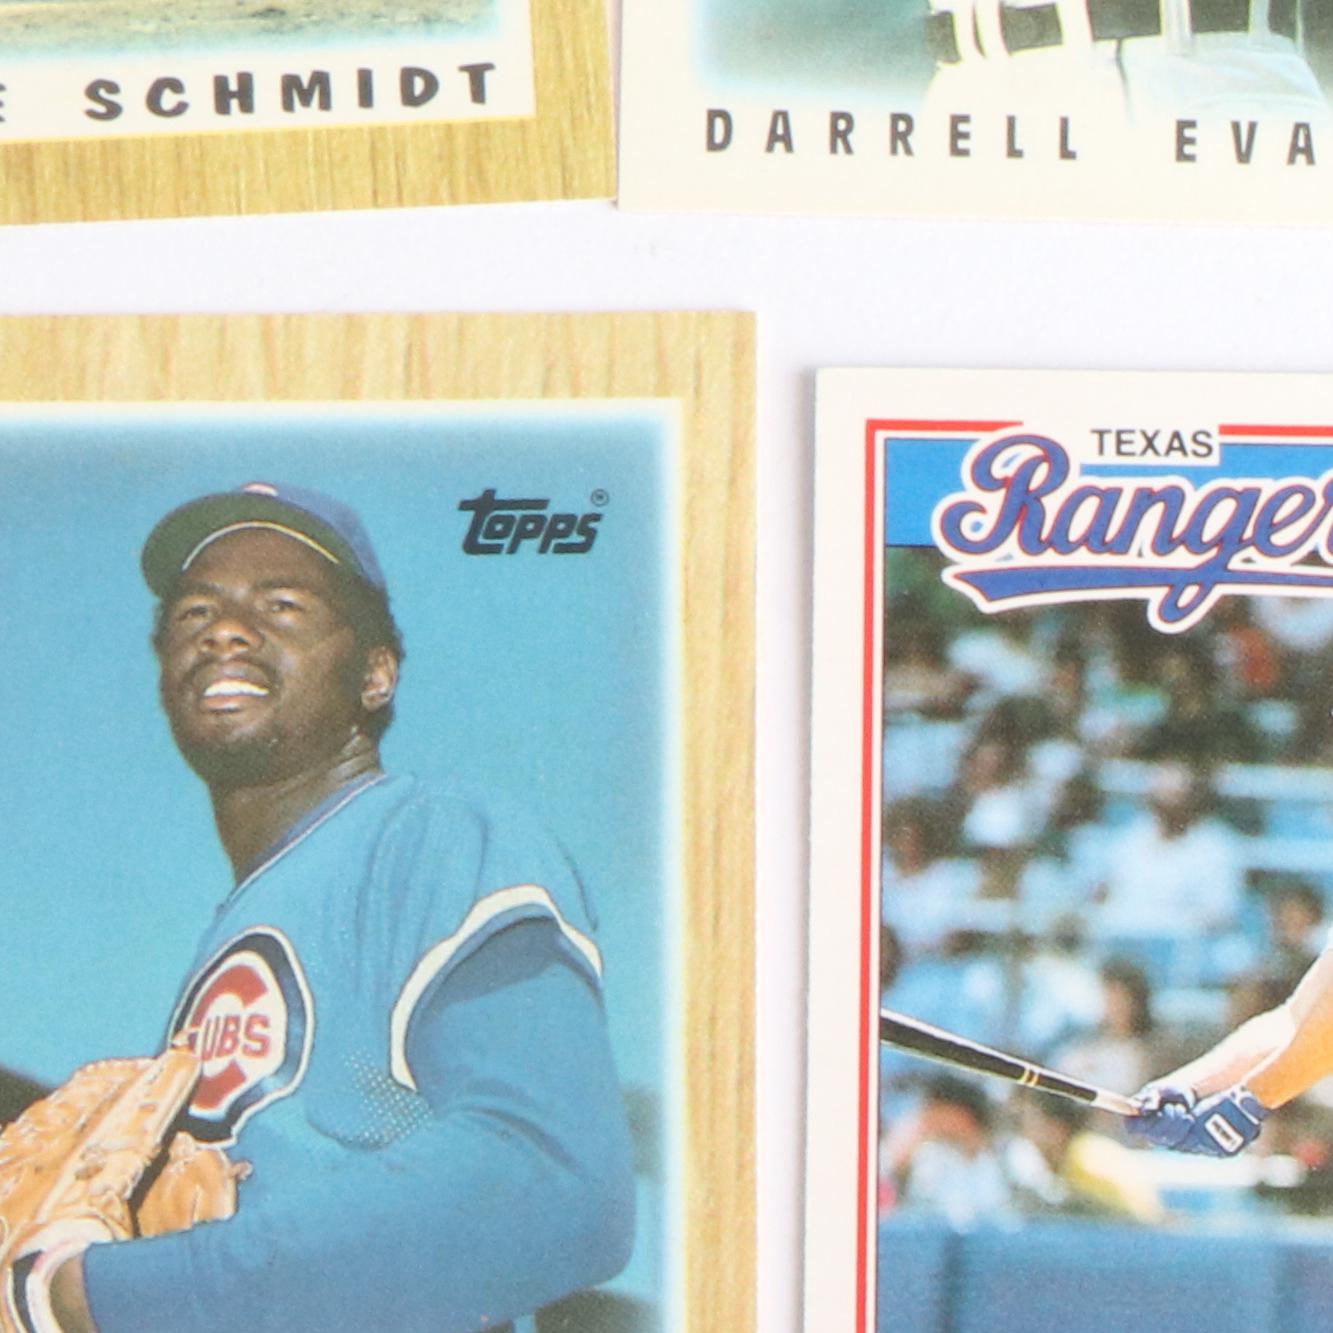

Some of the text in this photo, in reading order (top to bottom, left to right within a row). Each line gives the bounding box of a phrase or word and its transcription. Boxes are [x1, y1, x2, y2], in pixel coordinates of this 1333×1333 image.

[84, 61, 497, 121] SCHMIDT
[705, 109, 1078, 160] DARRELL
[1090, 427, 1214, 460] TEXAS
